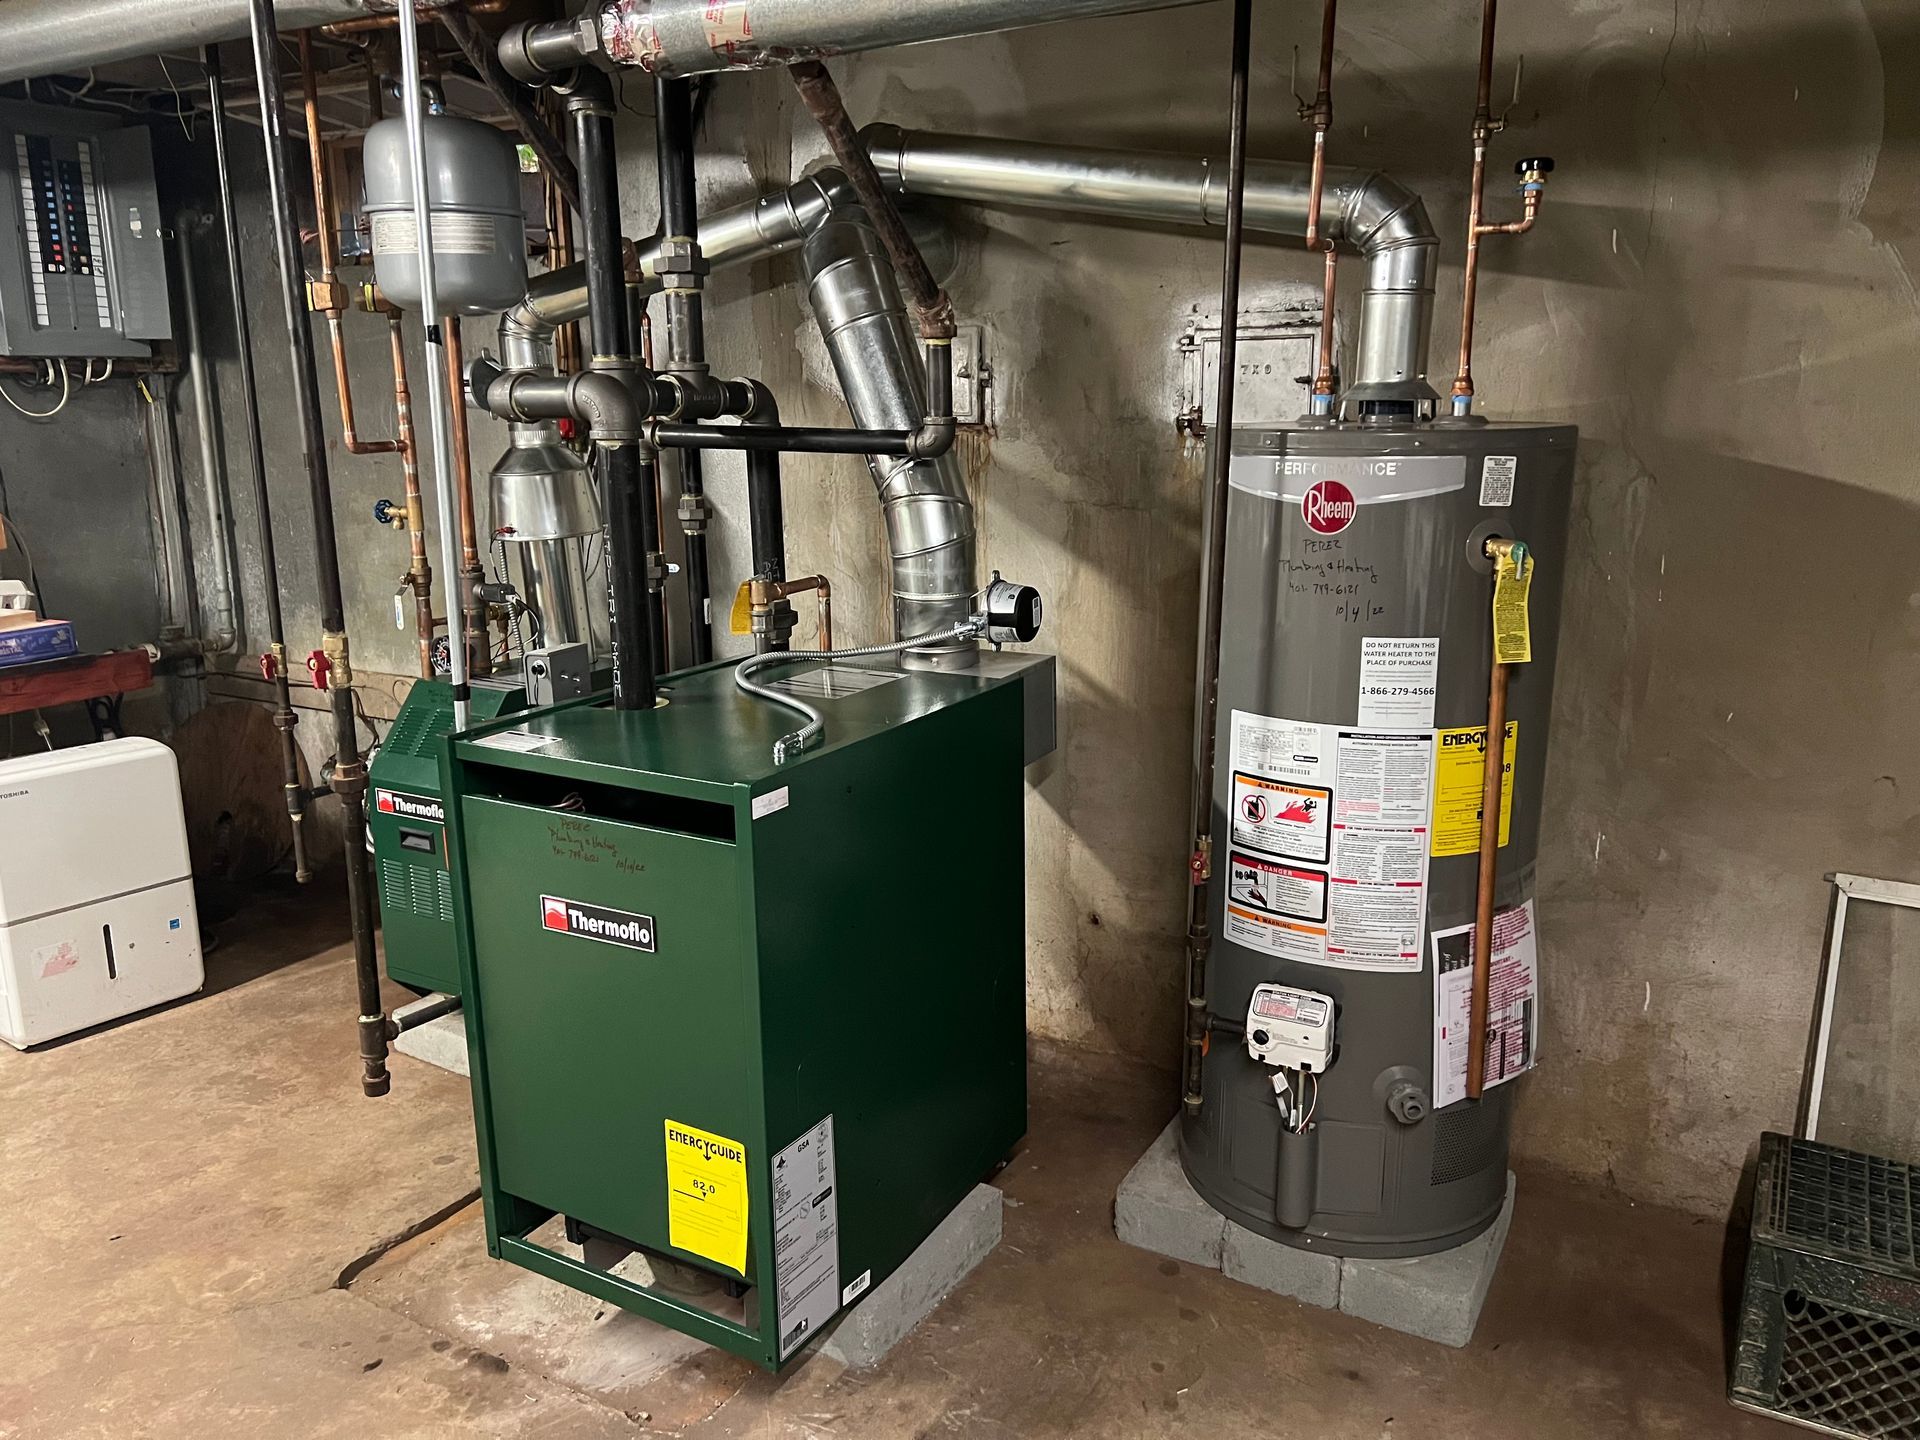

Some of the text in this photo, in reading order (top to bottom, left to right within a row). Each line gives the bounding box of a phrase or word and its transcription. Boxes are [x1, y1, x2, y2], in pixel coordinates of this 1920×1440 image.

[1275, 462, 1397, 476] PERFORMANCE
[1308, 481, 1352, 526] Rheem
[1303, 539, 1342, 554] PEREZ
[1361, 687, 1435, 695] 1-866-279-4566
[0, 790, 29, 799] TOSHIBA
[1265, 783, 1300, 794] WARNING
[393, 796, 444, 820] Thermoflo
[1263, 865, 1293, 876] DANGER
[568, 908, 650, 944] Thermoflo
[669, 1129, 742, 1163] ENERGYGUIDE
[797, 1139, 810, 1152] GSA
[692, 1179, 716, 1194] 82.0
